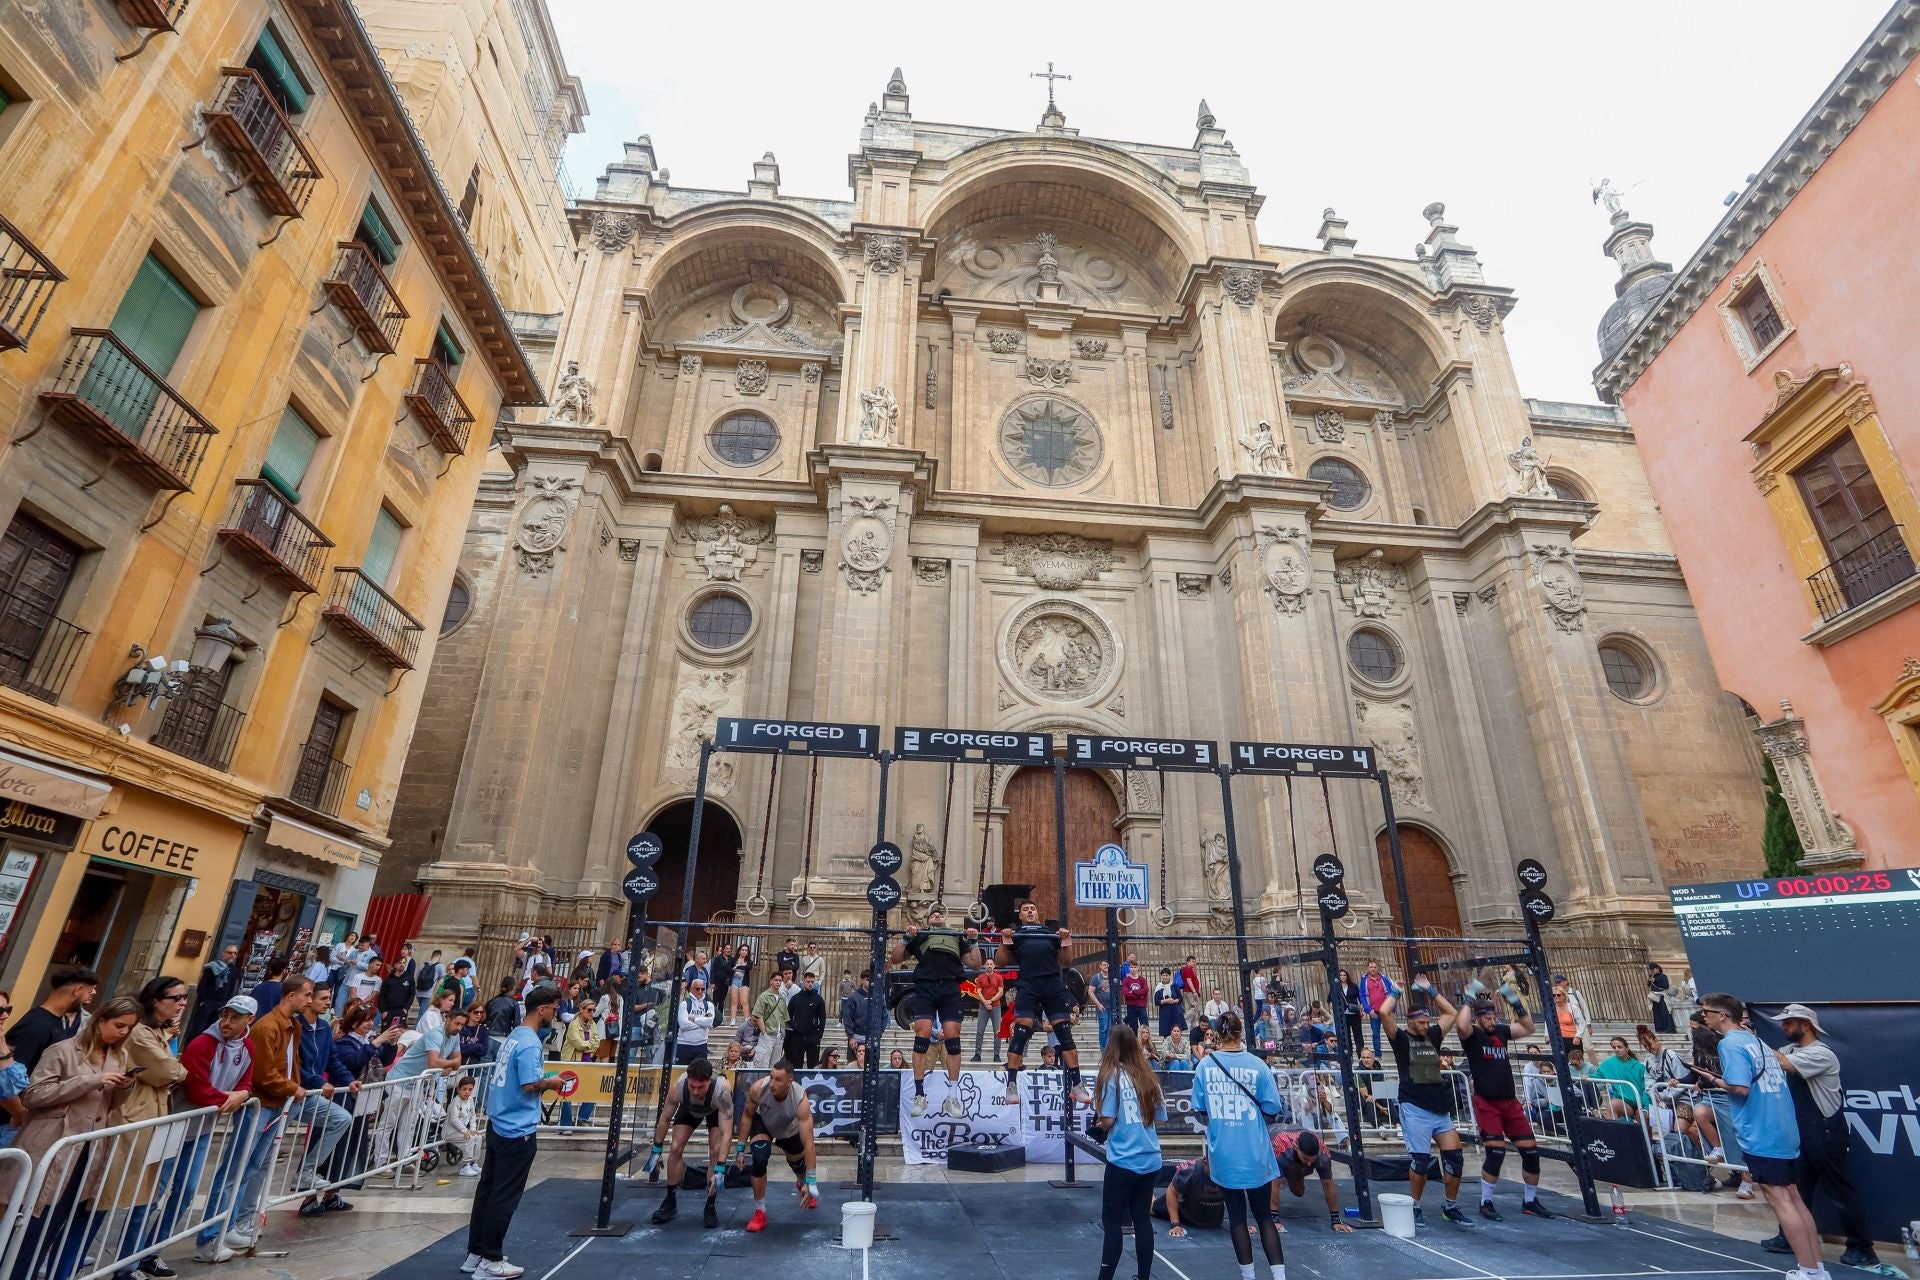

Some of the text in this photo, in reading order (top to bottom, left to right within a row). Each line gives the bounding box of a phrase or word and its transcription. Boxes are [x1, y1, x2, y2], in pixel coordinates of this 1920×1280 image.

[730, 722, 867, 748] 1 FORGED 1
[904, 731, 1044, 756] 2 FORGED 2
[1076, 739, 1210, 763] 3 FORGED 3
[1240, 746, 1369, 769] 4 FORGED 4
[101, 826, 199, 872] COFFEE
[1315, 866, 1343, 874] FORGED
[1082, 882, 1142, 900] THE BOX
[1735, 882, 1770, 899] UP
[1776, 873, 1892, 896] 00:00:25
[991, 1095, 1009, 1106] 202
[911, 1128, 946, 1150] The
[1587, 1146, 1616, 1156] FORGED
